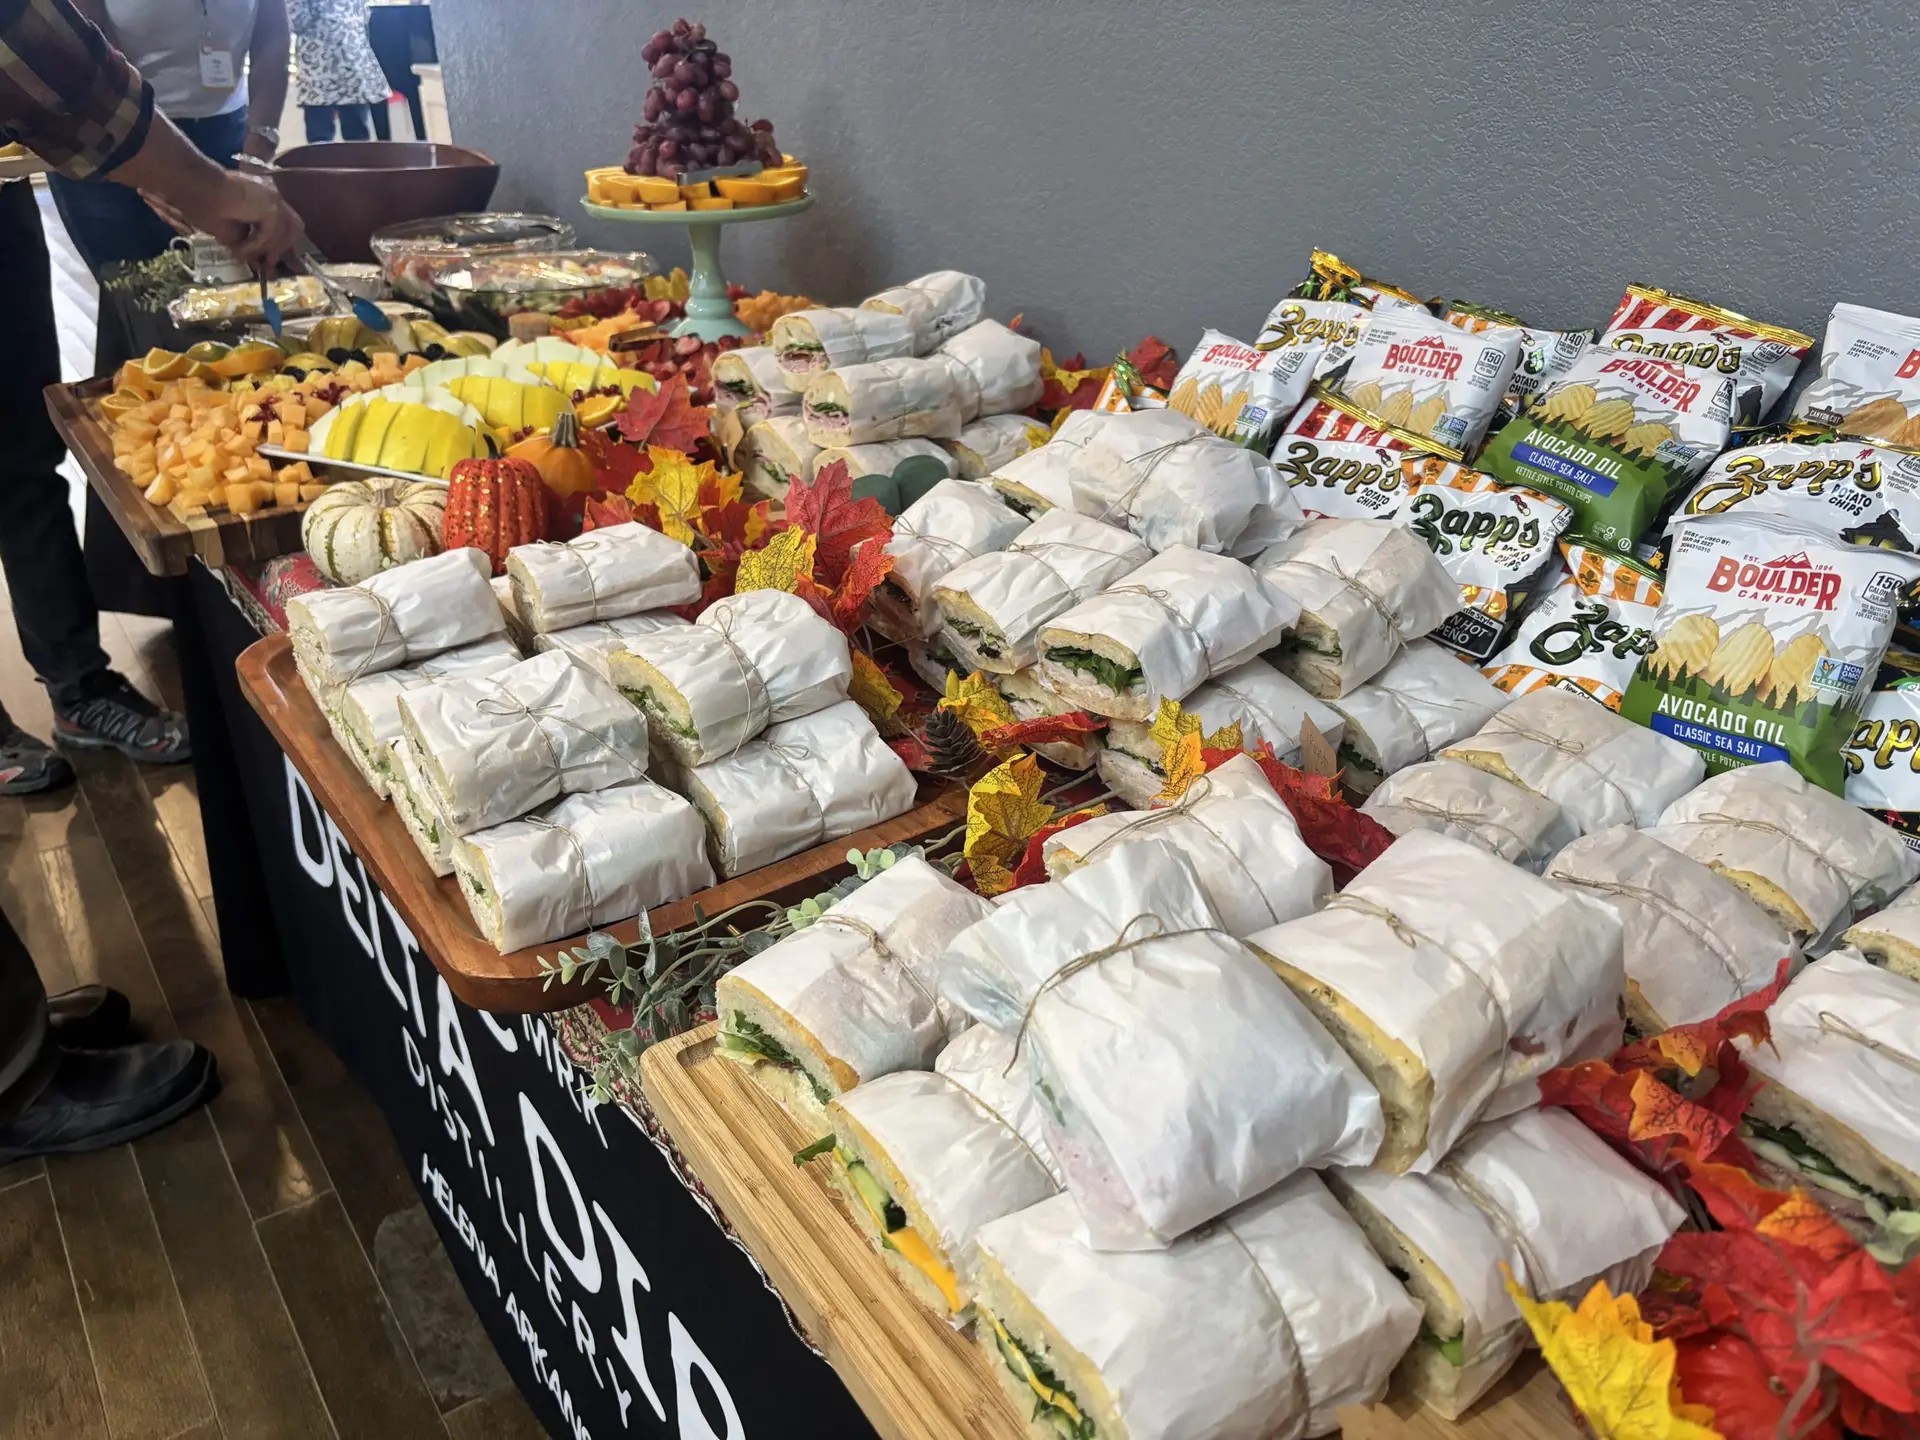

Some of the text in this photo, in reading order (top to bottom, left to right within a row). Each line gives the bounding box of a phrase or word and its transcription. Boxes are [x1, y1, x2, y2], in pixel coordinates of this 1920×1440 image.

[1382, 344, 1463, 380] BOULDER
[1483, 351, 1501, 365] 150
[1398, 365, 1440, 378] CANYON
[1511, 373, 1539, 389] POTATO
[1599, 359, 1702, 413] BOULDER
[1618, 372, 1669, 405] CANYON
[1809, 409, 1841, 423] CANYON CUT
[1524, 428, 1597, 469] AVOCADO
[1595, 454, 1623, 480] OIL
[1528, 451, 1596, 485] CLASSIC SEA SALT
[1515, 465, 1593, 504] KETTLE STYLE POTATO CHIPS
[1356, 496, 1381, 511] CHIPS
[1361, 487, 1390, 505] POTATO
[1829, 496, 1864, 516] CHIPS
[1831, 484, 1872, 508] POTATO
[1743, 554, 1760, 564] EST.
[1706, 556, 1842, 611] BOULDER
[1738, 589, 1807, 607] CANYON
[1460, 620, 1488, 637] HOT
[1475, 613, 1494, 626] Style
[1842, 670, 1860, 680] GMO
[1844, 664, 1862, 674] NON
[1657, 693, 1786, 747] AVOCADO OIL
[1673, 724, 1763, 758] CLASSIC SEA SALT
[284, 752, 495, 1147] DELTA
[402, 1025, 632, 1428] DISTILLERY
[422, 1153, 501, 1298] HELENA
